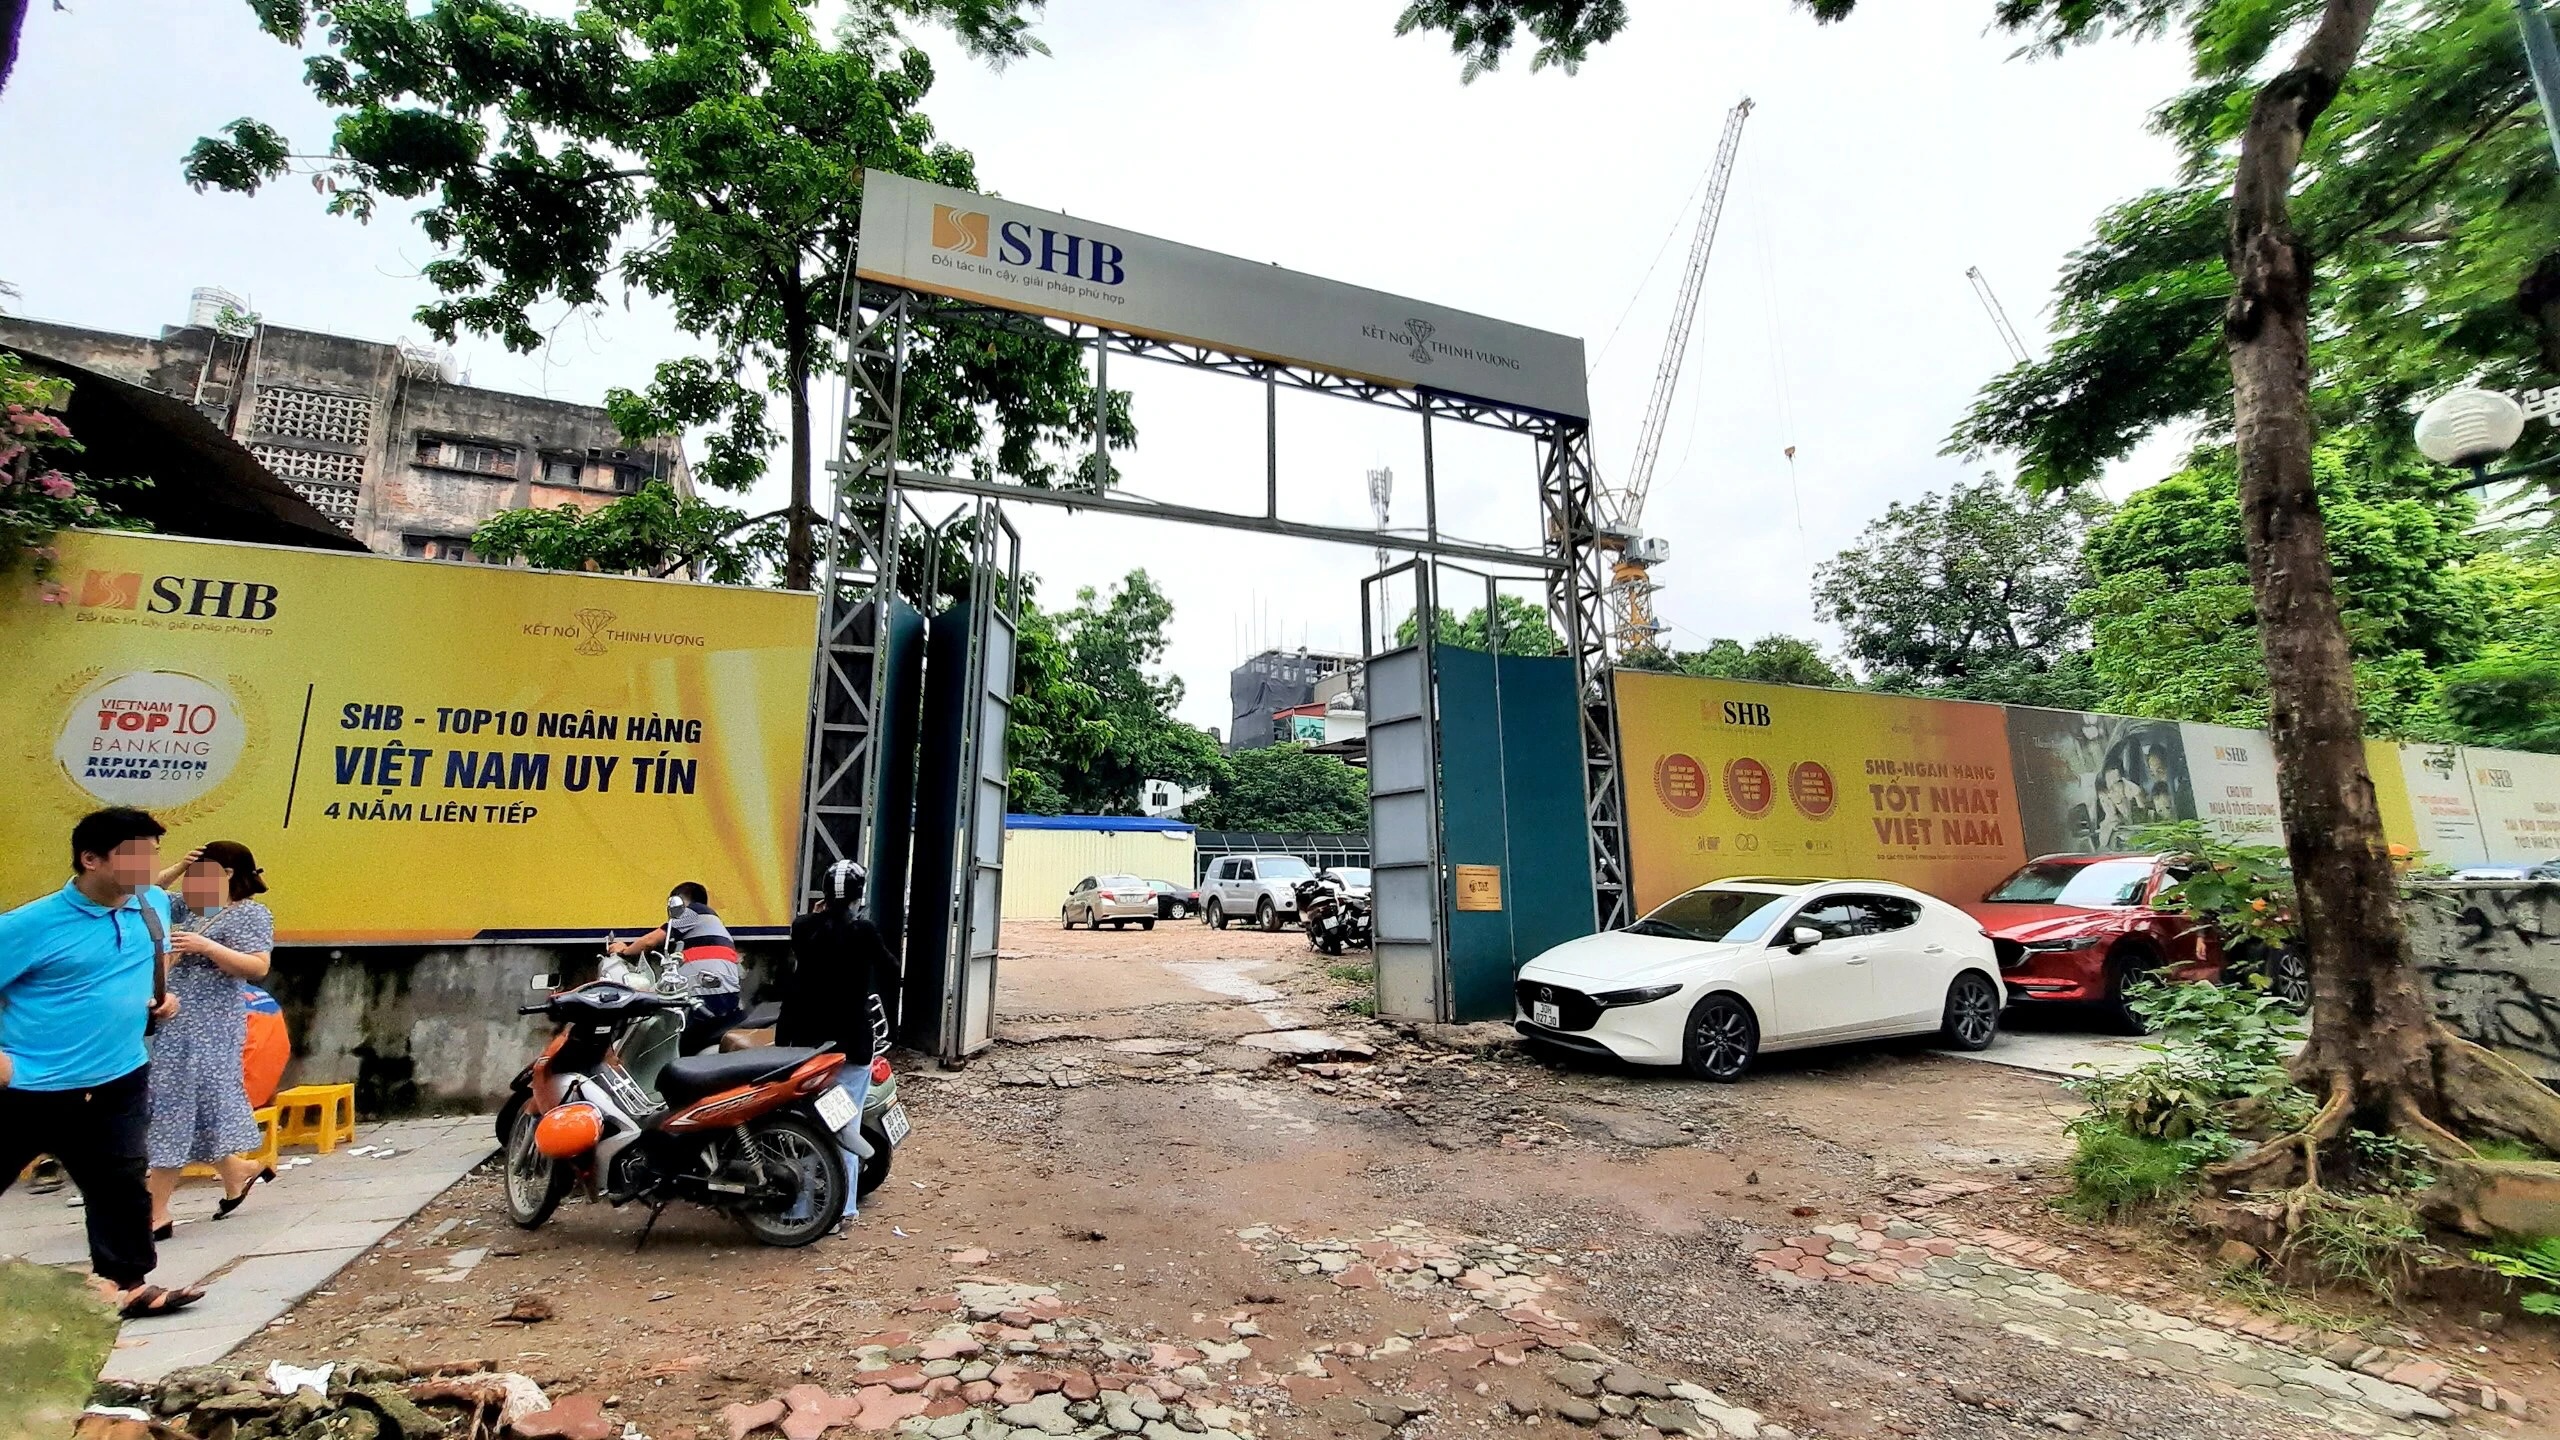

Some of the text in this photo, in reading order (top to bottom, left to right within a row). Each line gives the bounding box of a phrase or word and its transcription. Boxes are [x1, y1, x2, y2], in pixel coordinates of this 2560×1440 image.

[1000, 220, 1125, 286] SHB
[931, 254, 953, 268] Đối
[957, 260, 975, 273] tác
[978, 263, 992, 276] tin
[1047, 278, 1075, 296] pháp
[1102, 291, 1125, 305] hợp
[146, 575, 279, 621] SHB
[97, 703, 217, 735] TOP 10
[101, 698, 173, 713] VIETNAM
[1723, 700, 1772, 727] SHB
[340, 702, 703, 744] SHB - TOP10 NGÂN HÀNG
[92, 736, 211, 756] BANKING
[2225, 747, 2249, 762] SHB
[84, 767, 205, 781] AWARD 2019
[87, 756, 208, 771] REPUTATION
[334, 739, 699, 796] VIỆT NAM UY TÍN
[1868, 775, 1921, 812] TỐT
[323, 798, 539, 825] 4 NĂM LIÊN TIẾP
[1872, 812, 1933, 851] VIỆT
[1941, 818, 2005, 846] NAM
